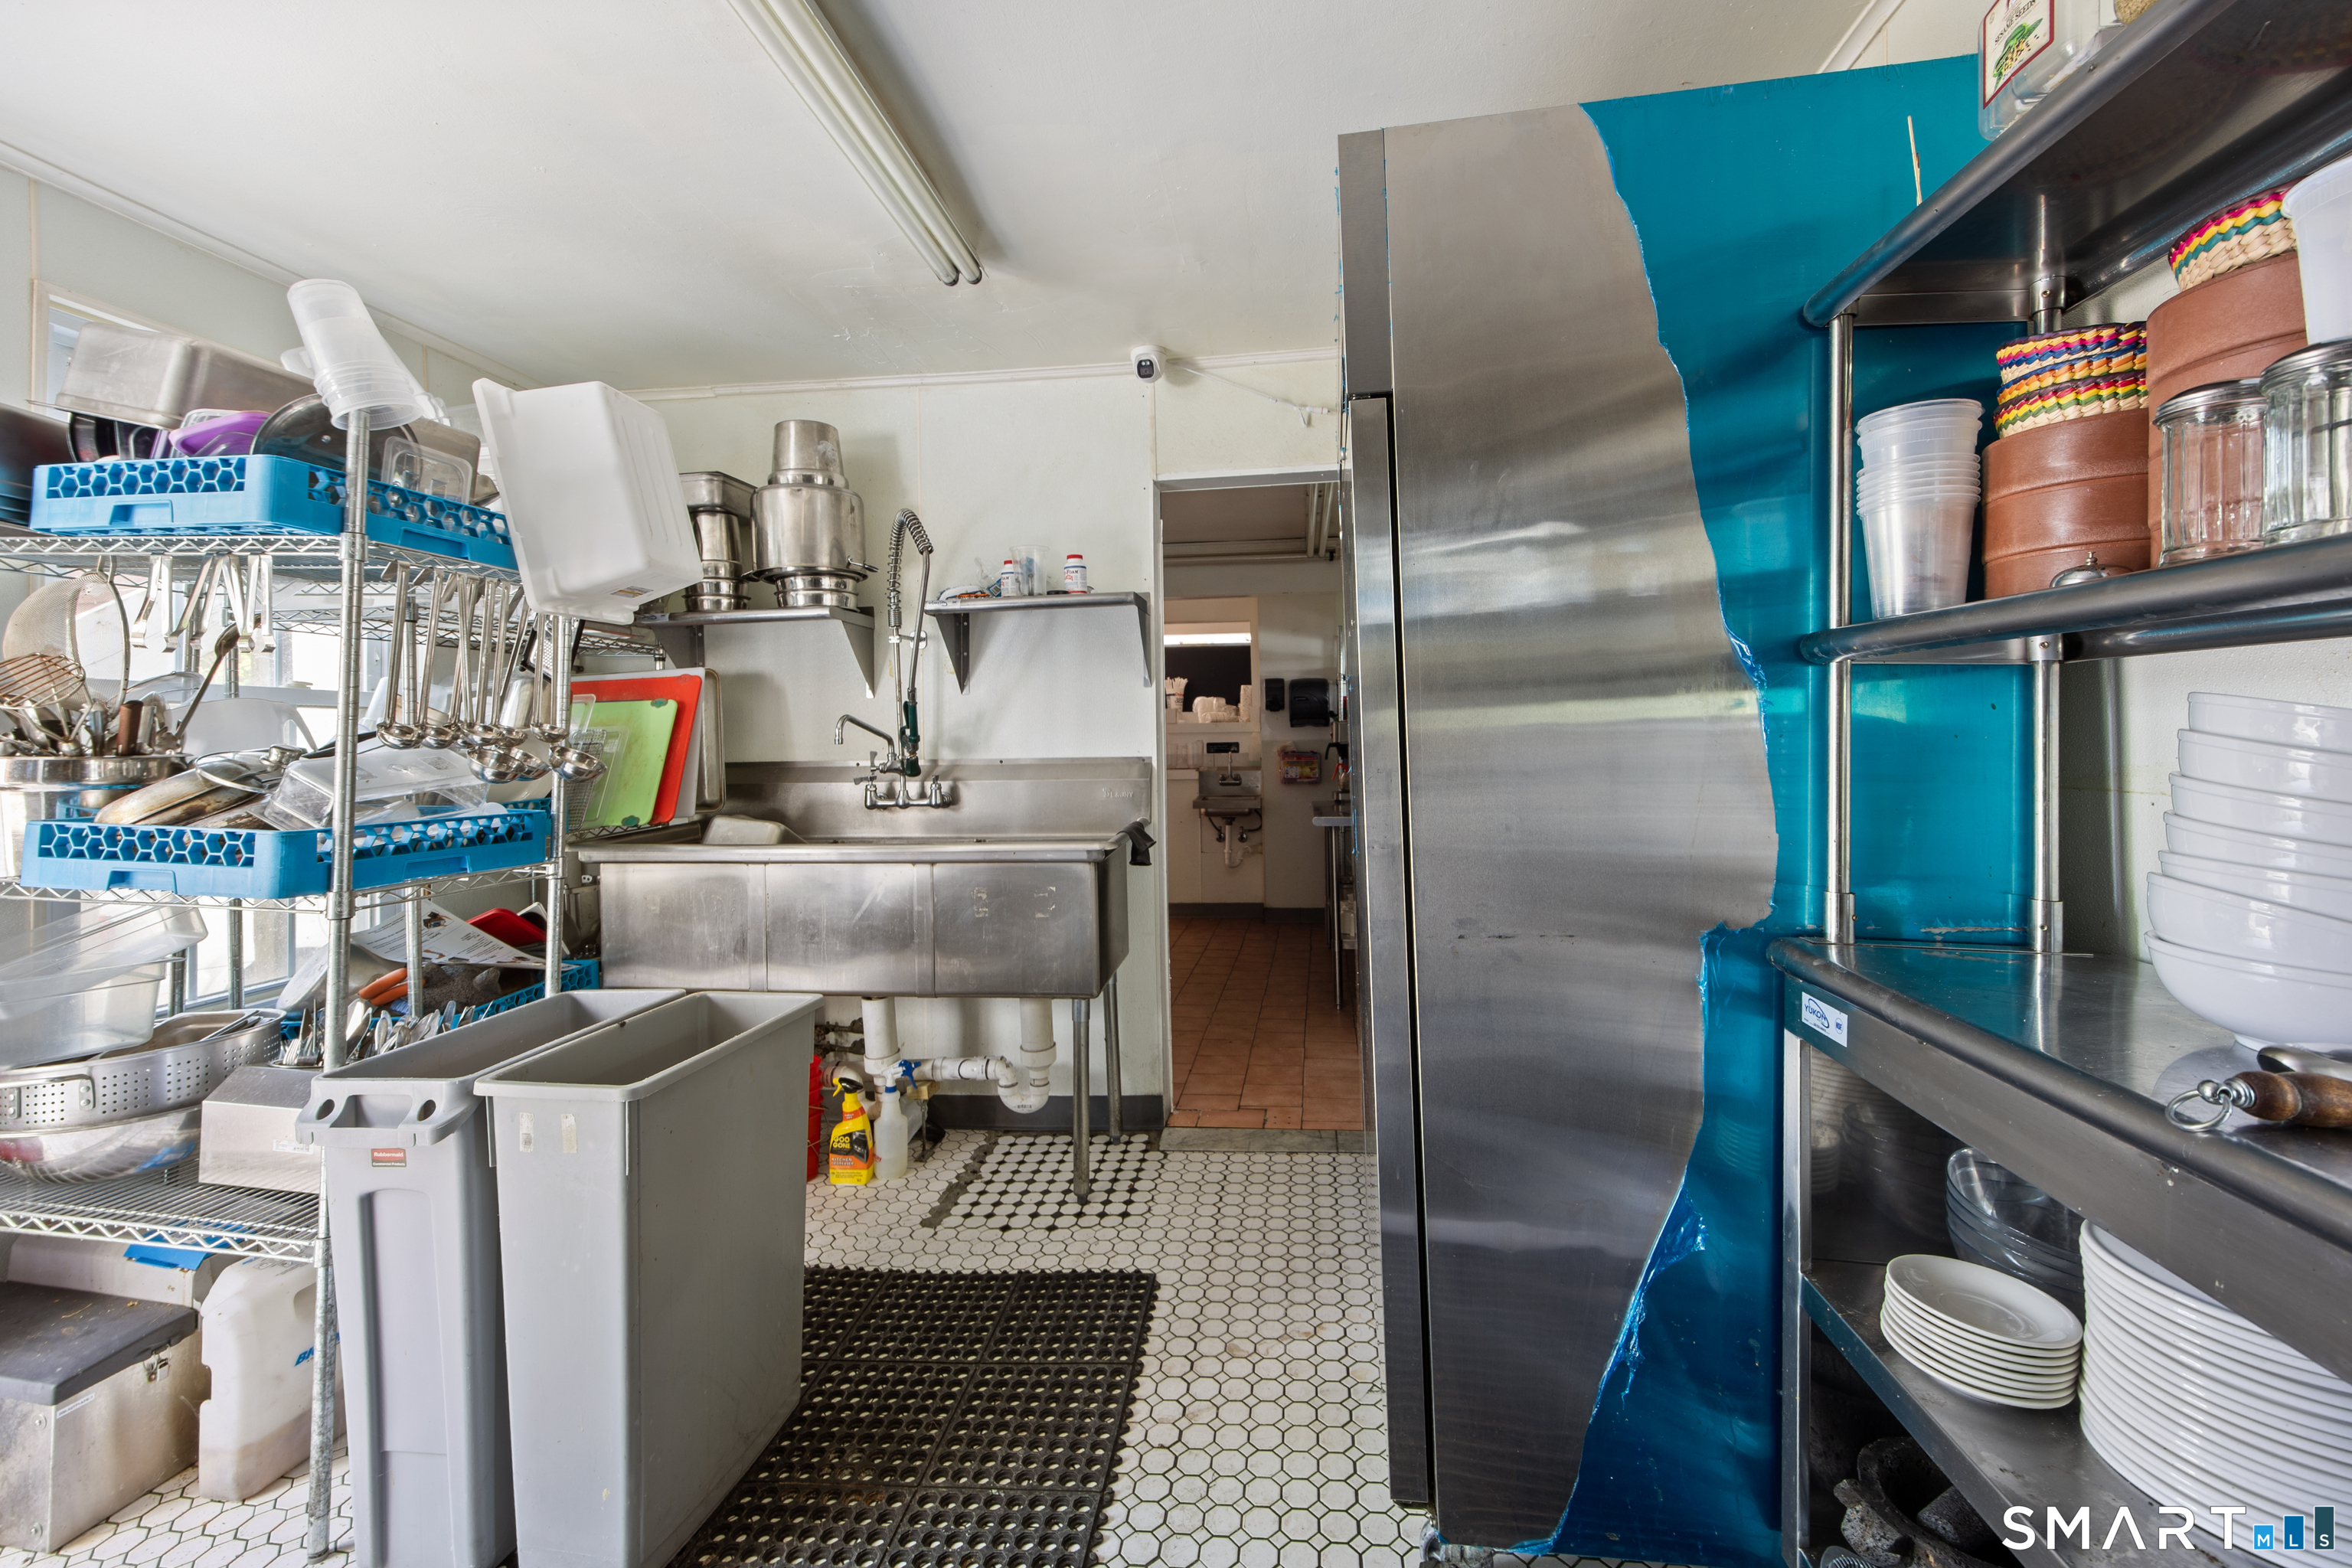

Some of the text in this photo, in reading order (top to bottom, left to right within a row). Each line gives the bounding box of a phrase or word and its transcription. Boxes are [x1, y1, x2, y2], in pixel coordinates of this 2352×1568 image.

[1994, 18, 2015, 45] SESAME
[2015, 0, 2037, 21] SEEDS
[1804, 1004, 1827, 1022] YUKON
